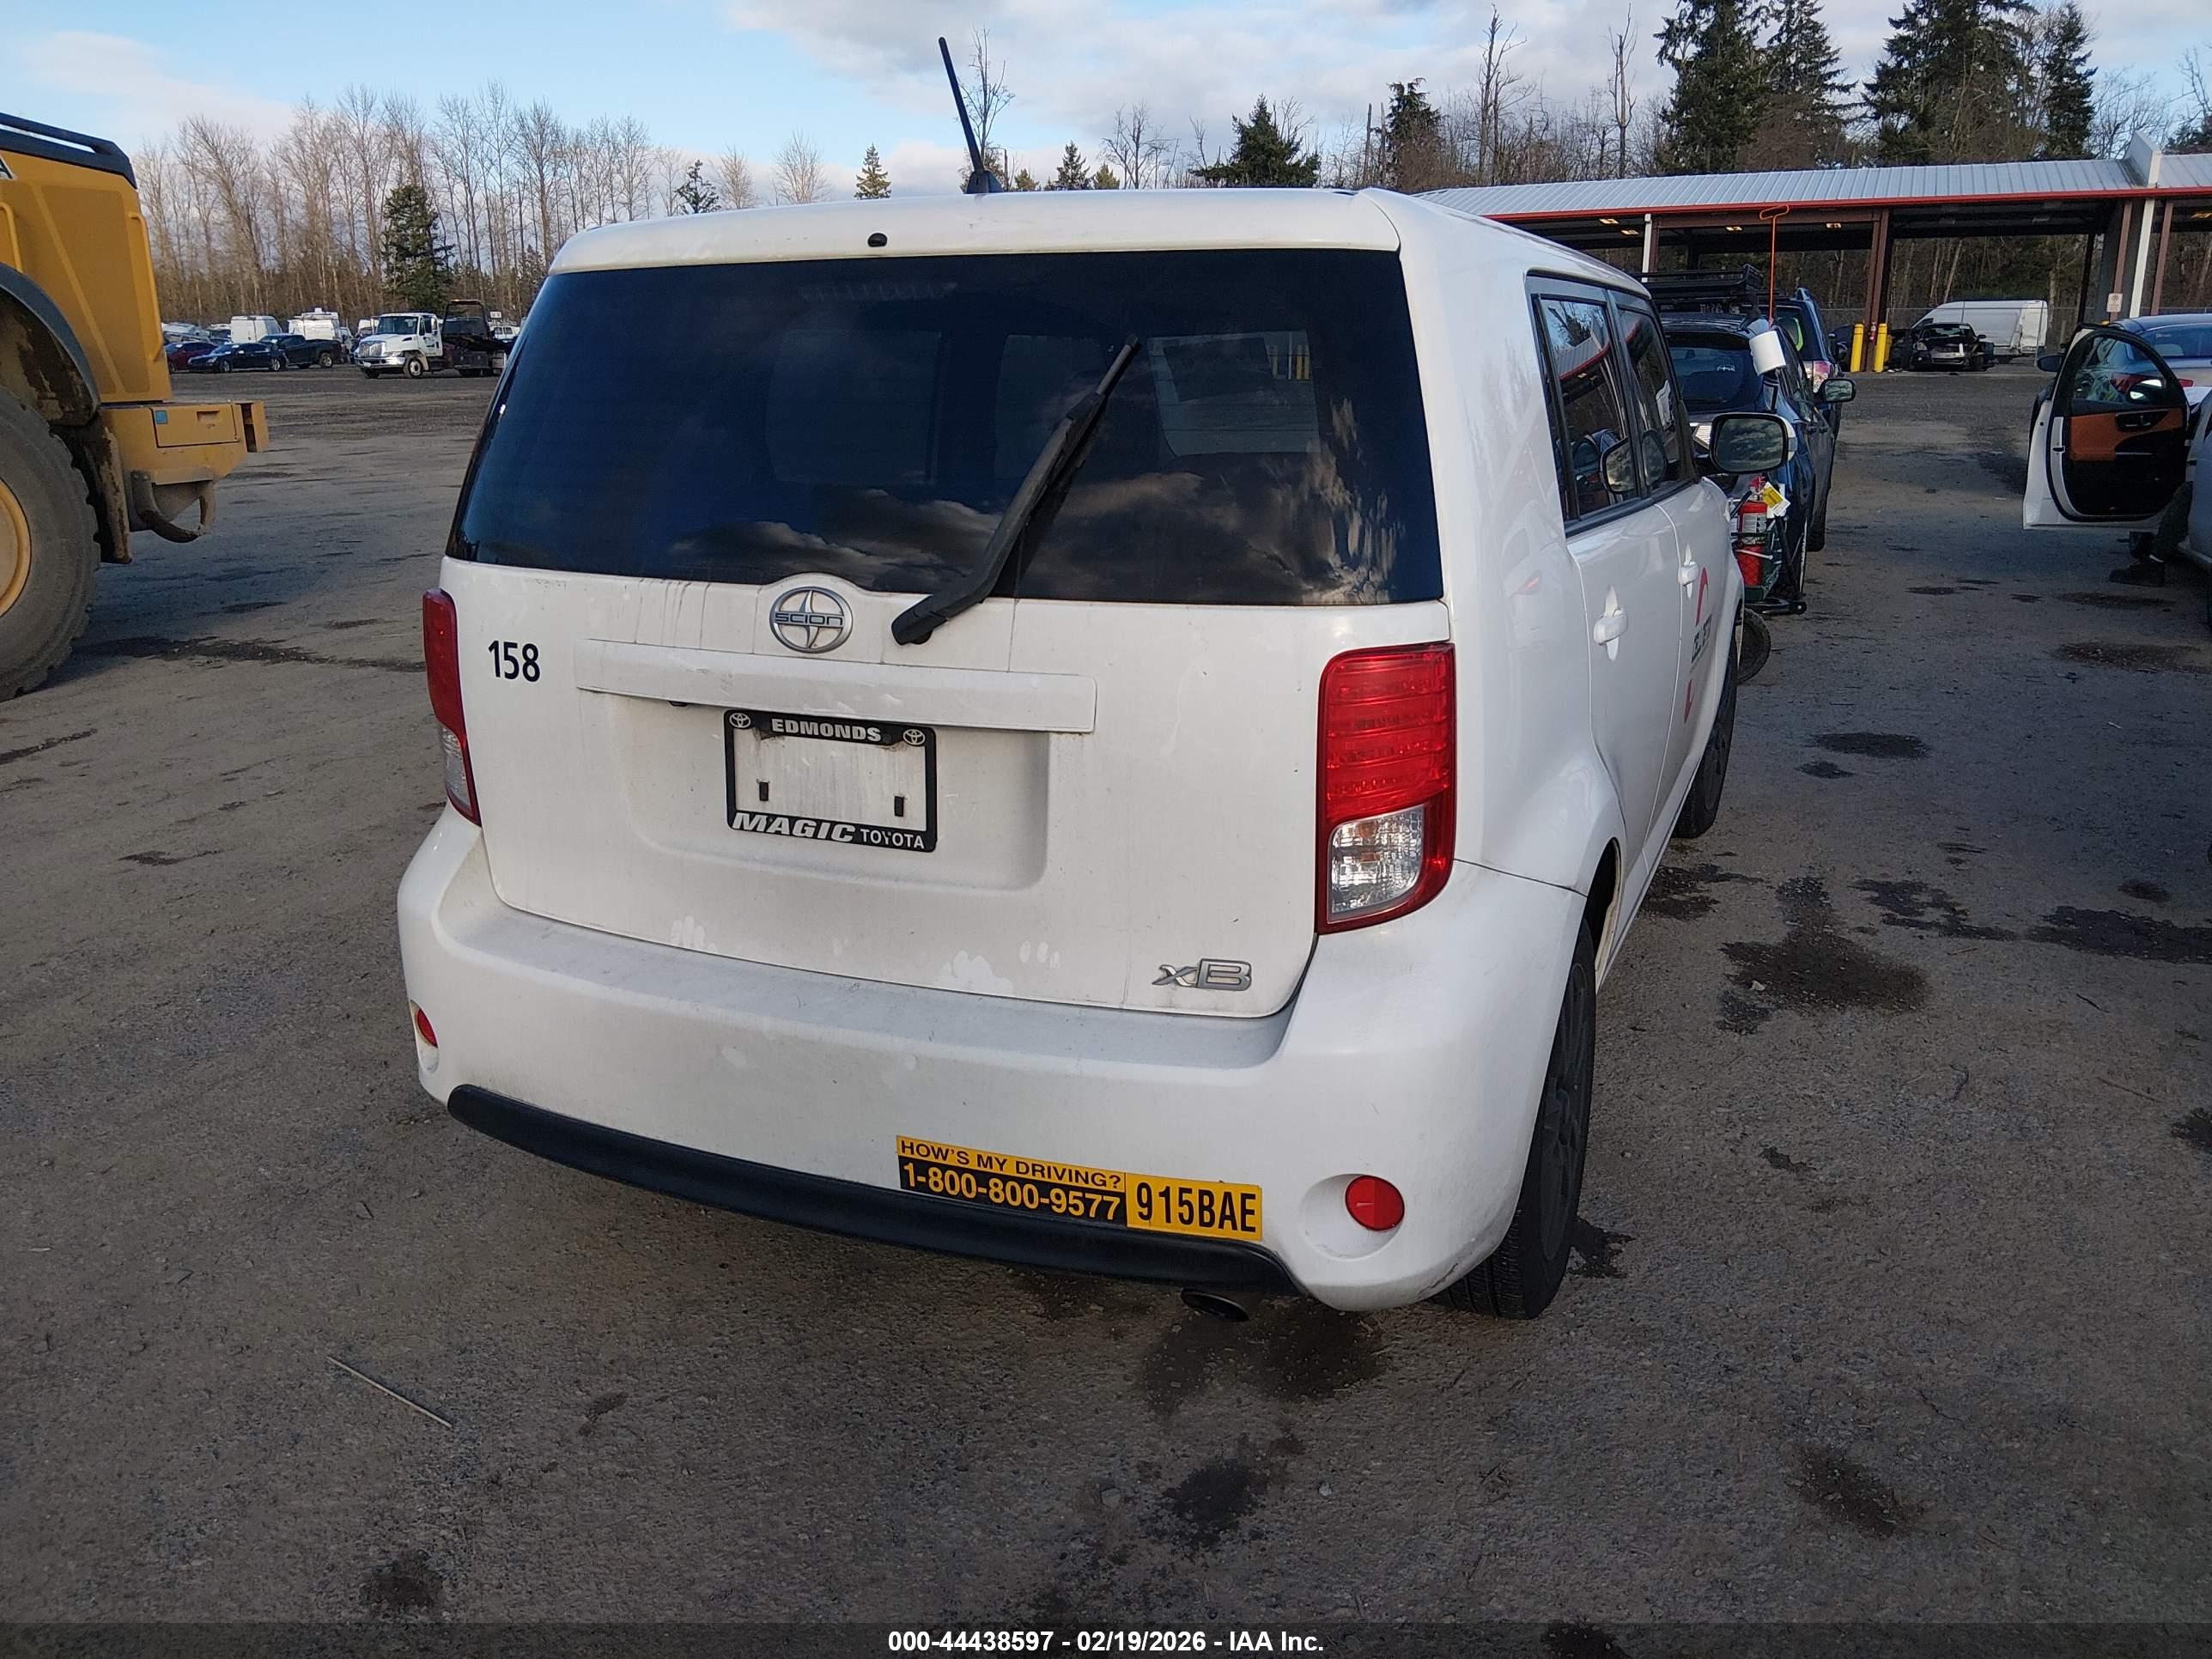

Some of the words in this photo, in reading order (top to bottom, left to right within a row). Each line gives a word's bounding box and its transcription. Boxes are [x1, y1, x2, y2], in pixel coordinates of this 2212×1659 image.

[488, 640, 541, 683] 158
[771, 718, 882, 742] EDMONDS
[732, 812, 856, 842] MAGIC
[860, 828, 926, 850] TOYOTA
[901, 1139, 970, 1165] HOW'S
[976, 1153, 1009, 1172] MY
[1015, 1160, 1121, 1189] DRIVING?
[903, 1162, 1121, 1220] 1-800-800-9577
[1136, 1182, 1257, 1233] 915BAE
